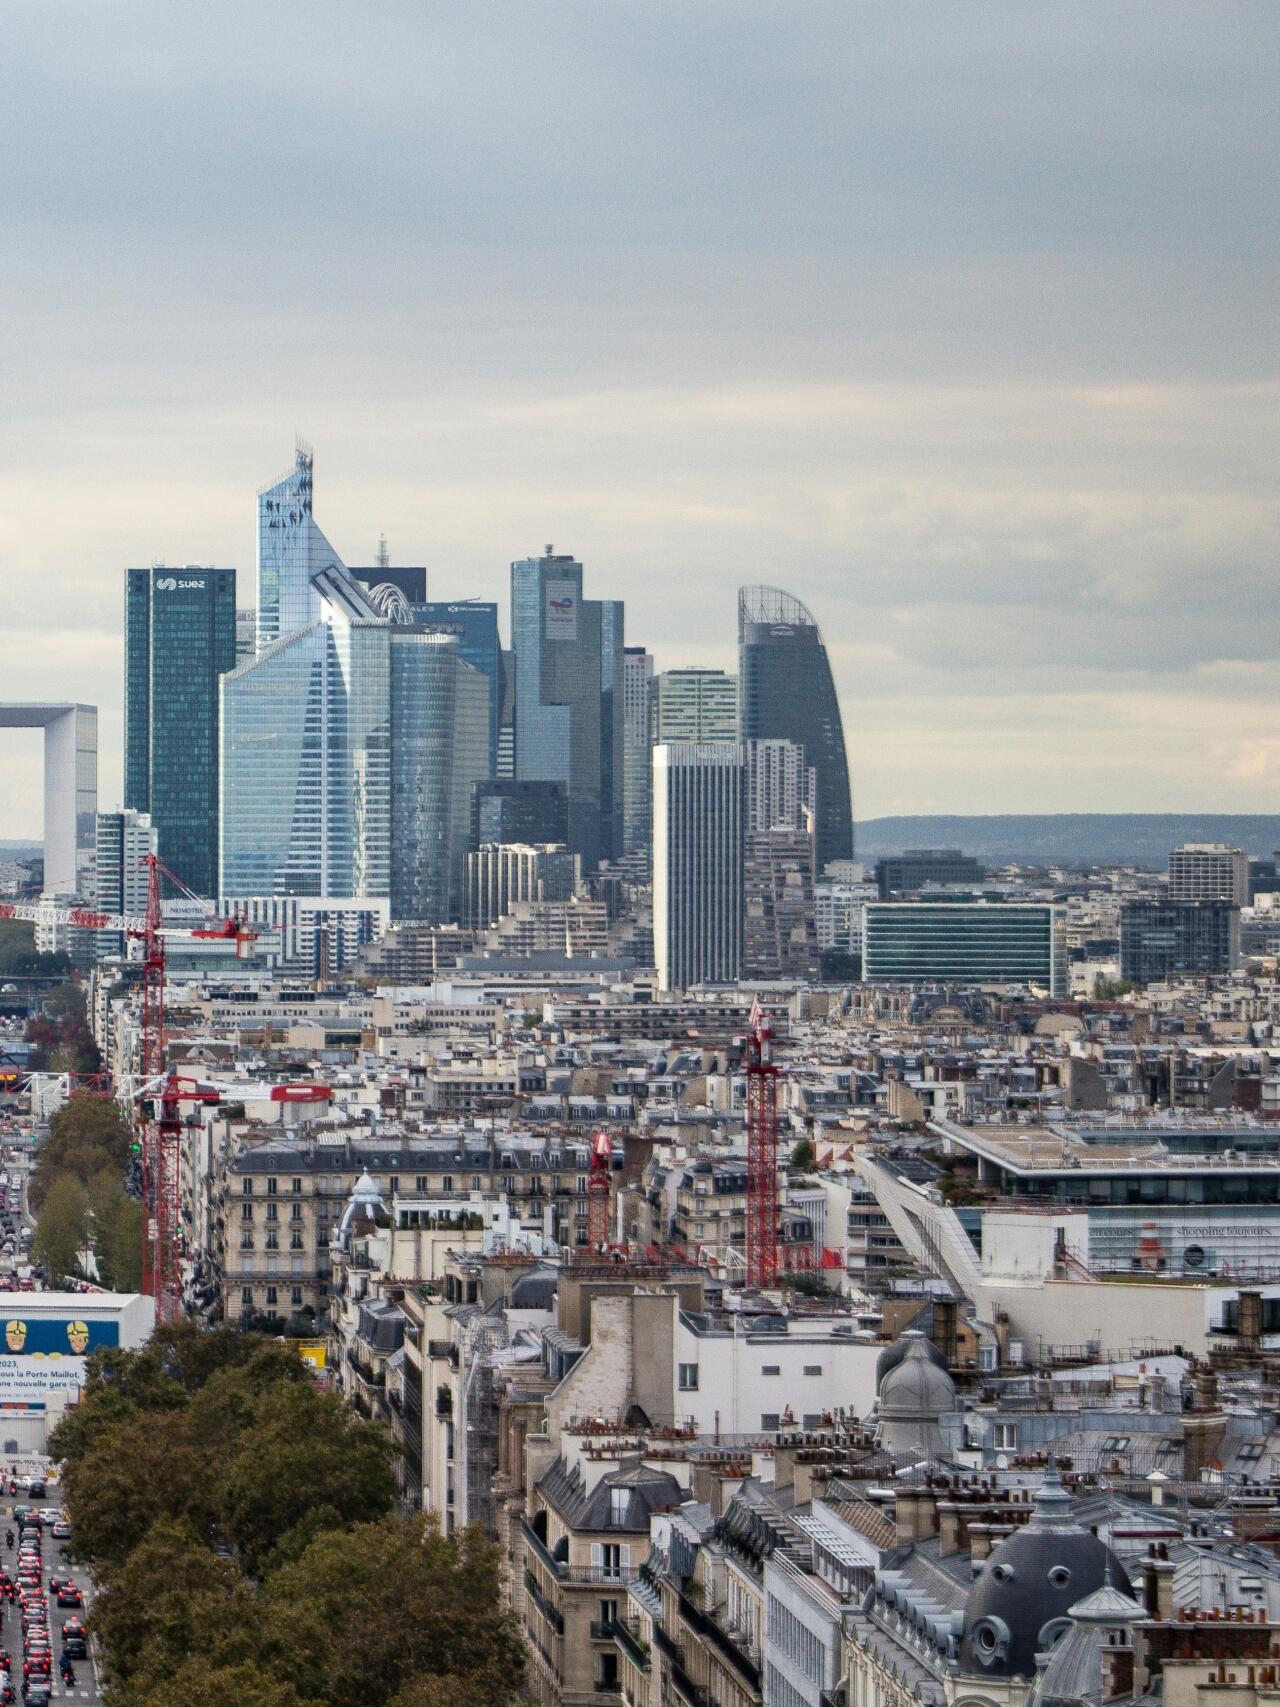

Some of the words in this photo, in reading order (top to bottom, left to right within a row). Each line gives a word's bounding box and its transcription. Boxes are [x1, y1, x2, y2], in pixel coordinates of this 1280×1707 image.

[1177, 1226, 1225, 1238] shopping
[17, 1369, 24, 1377] la
[51, 1370, 80, 1378] Maillot,
